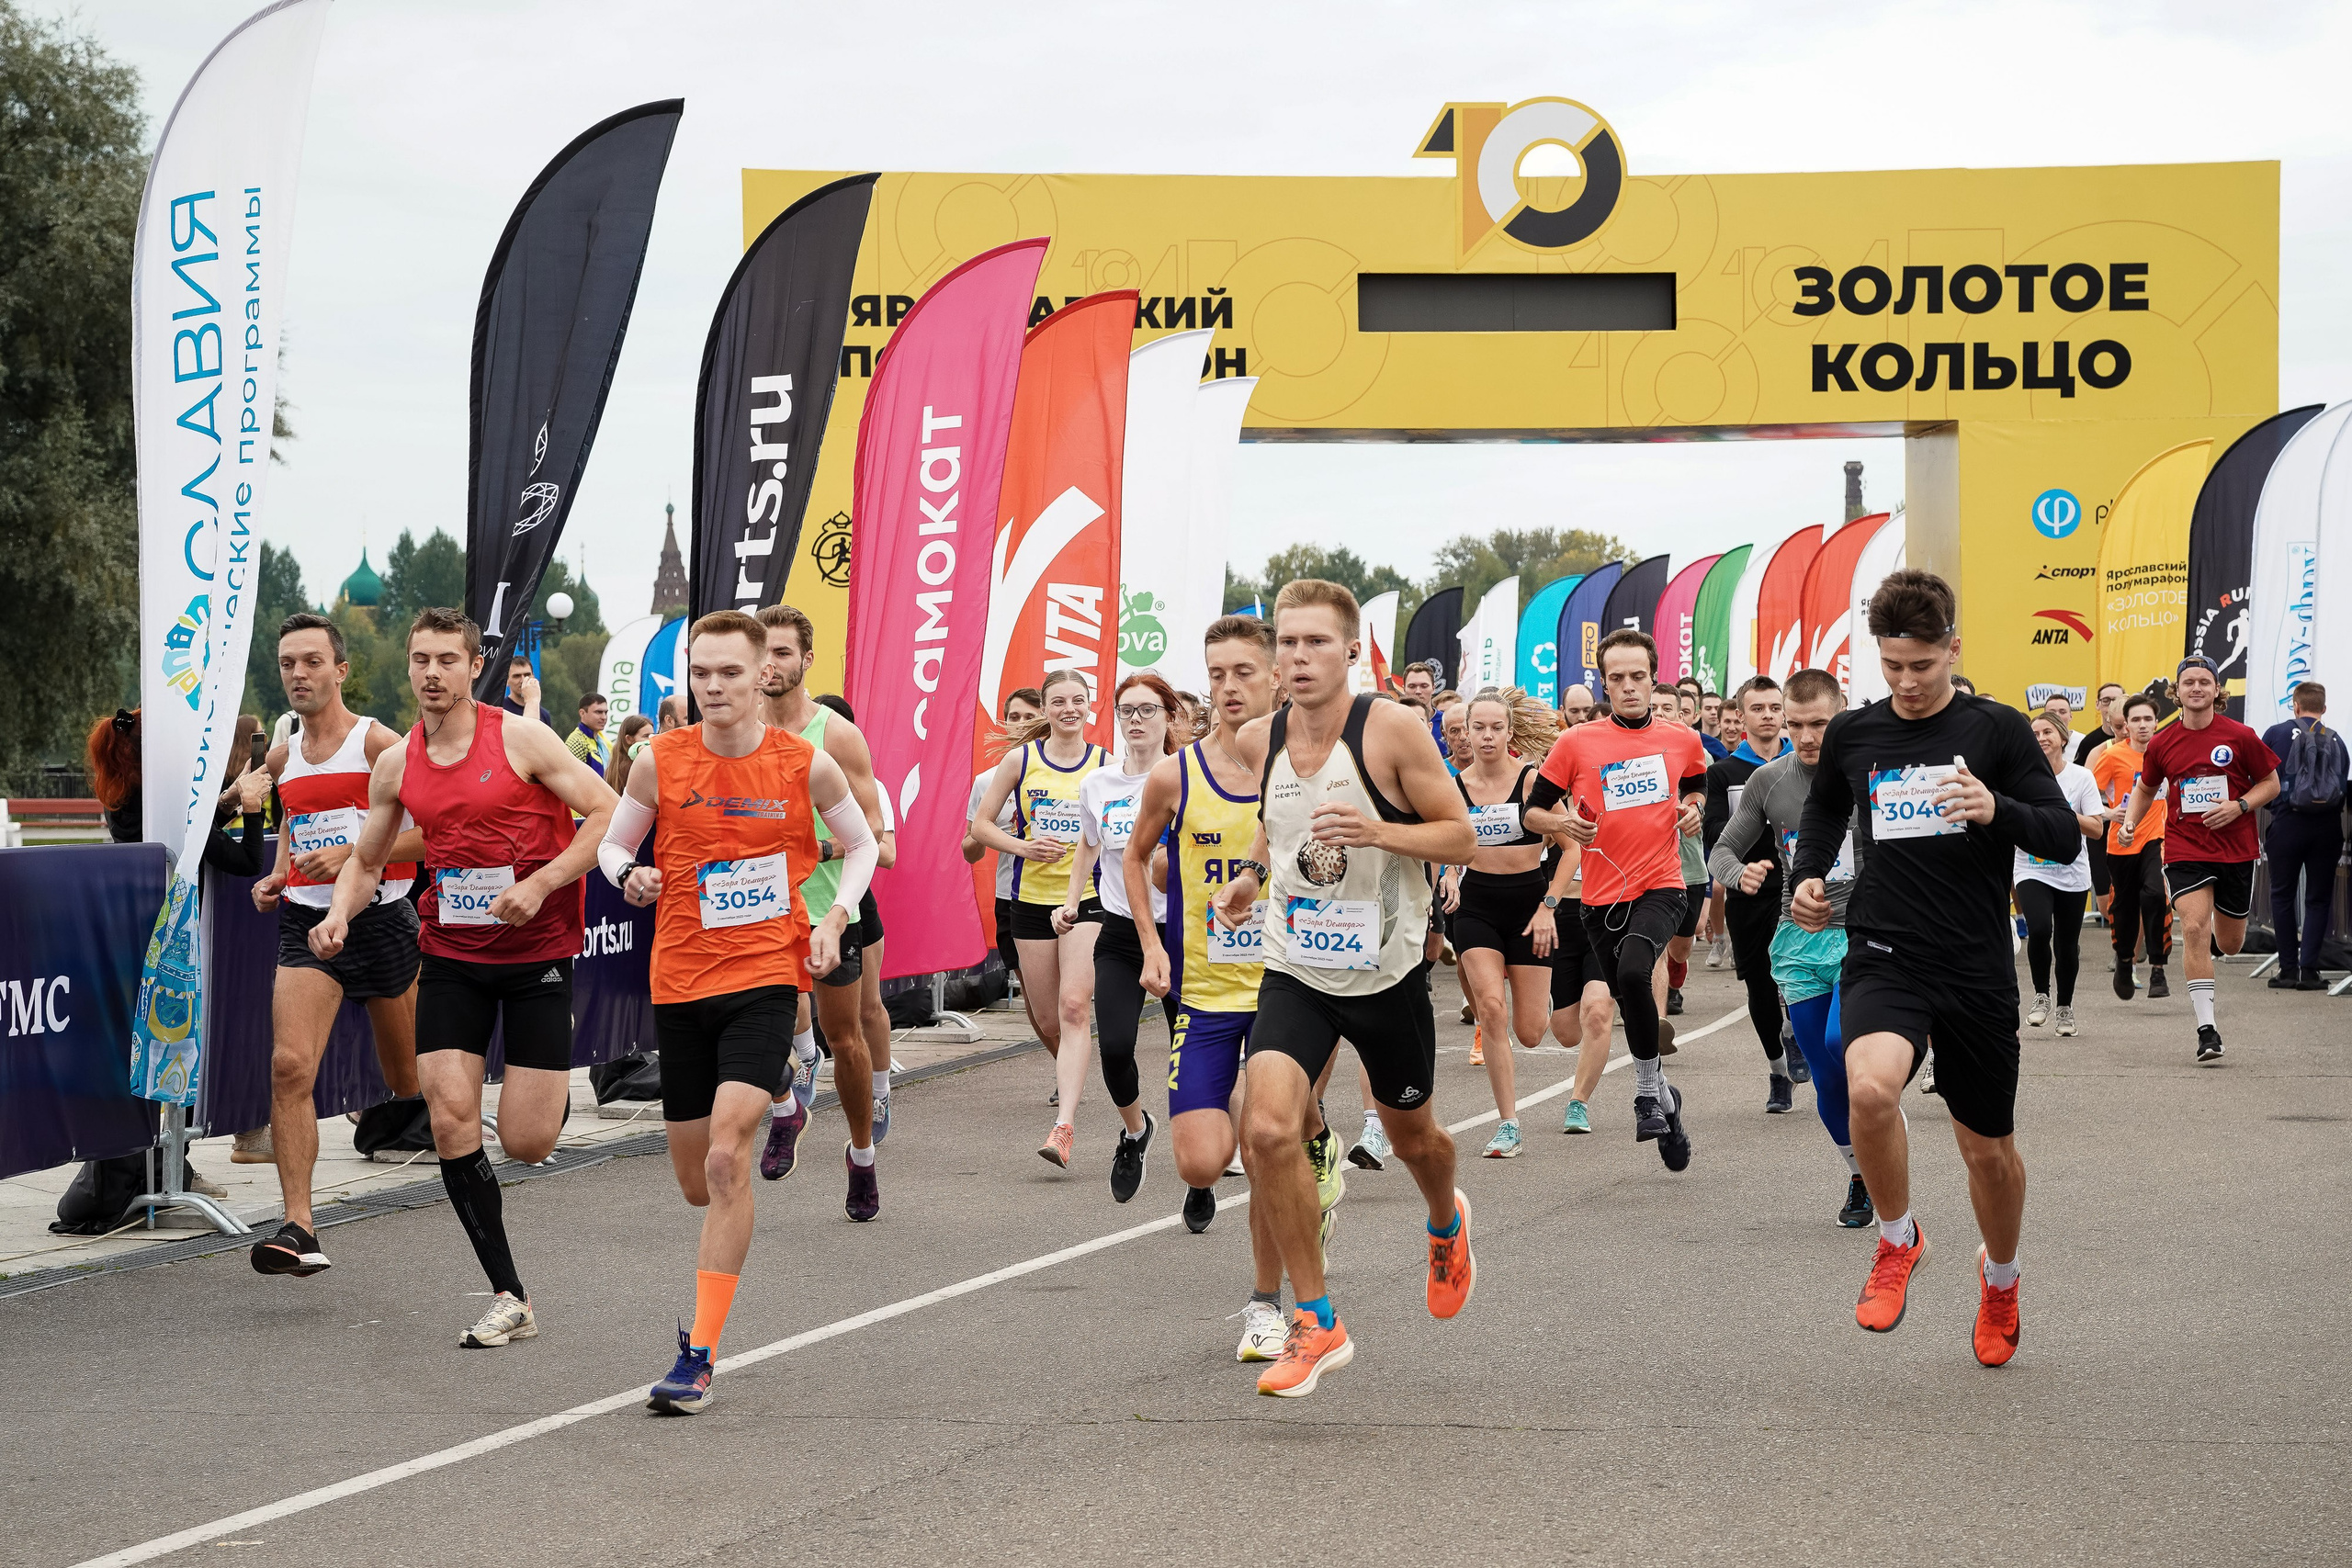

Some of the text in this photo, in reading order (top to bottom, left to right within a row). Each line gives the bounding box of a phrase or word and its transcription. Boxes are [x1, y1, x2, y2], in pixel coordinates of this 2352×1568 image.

[1792, 263, 2150, 317] ЗОЛОТОЕ
[239, 186, 264, 464] программы
[1812, 339, 2132, 398] КОЛЬЦО
[171, 190, 221, 581] СЛАВИЯ
[2031, 629, 2069, 645] ANTA
[1585, 626, 1595, 665] PRO
[1026, 789, 1049, 797] YSU
[1274, 791, 1301, 799] НЕФТИ
[1614, 778, 1657, 797] 3055
[705, 796, 789, 811] DEMIX
[2188, 792, 2221, 804] 3007
[756, 810, 785, 819] TRAINING
[1039, 818, 1080, 833] 3095
[1475, 823, 1511, 837] 3052
[1192, 832, 1222, 845] YSU
[714, 885, 777, 911] 3054
[1222, 931, 1262, 948] 302
[1300, 929, 1363, 953] 3024
